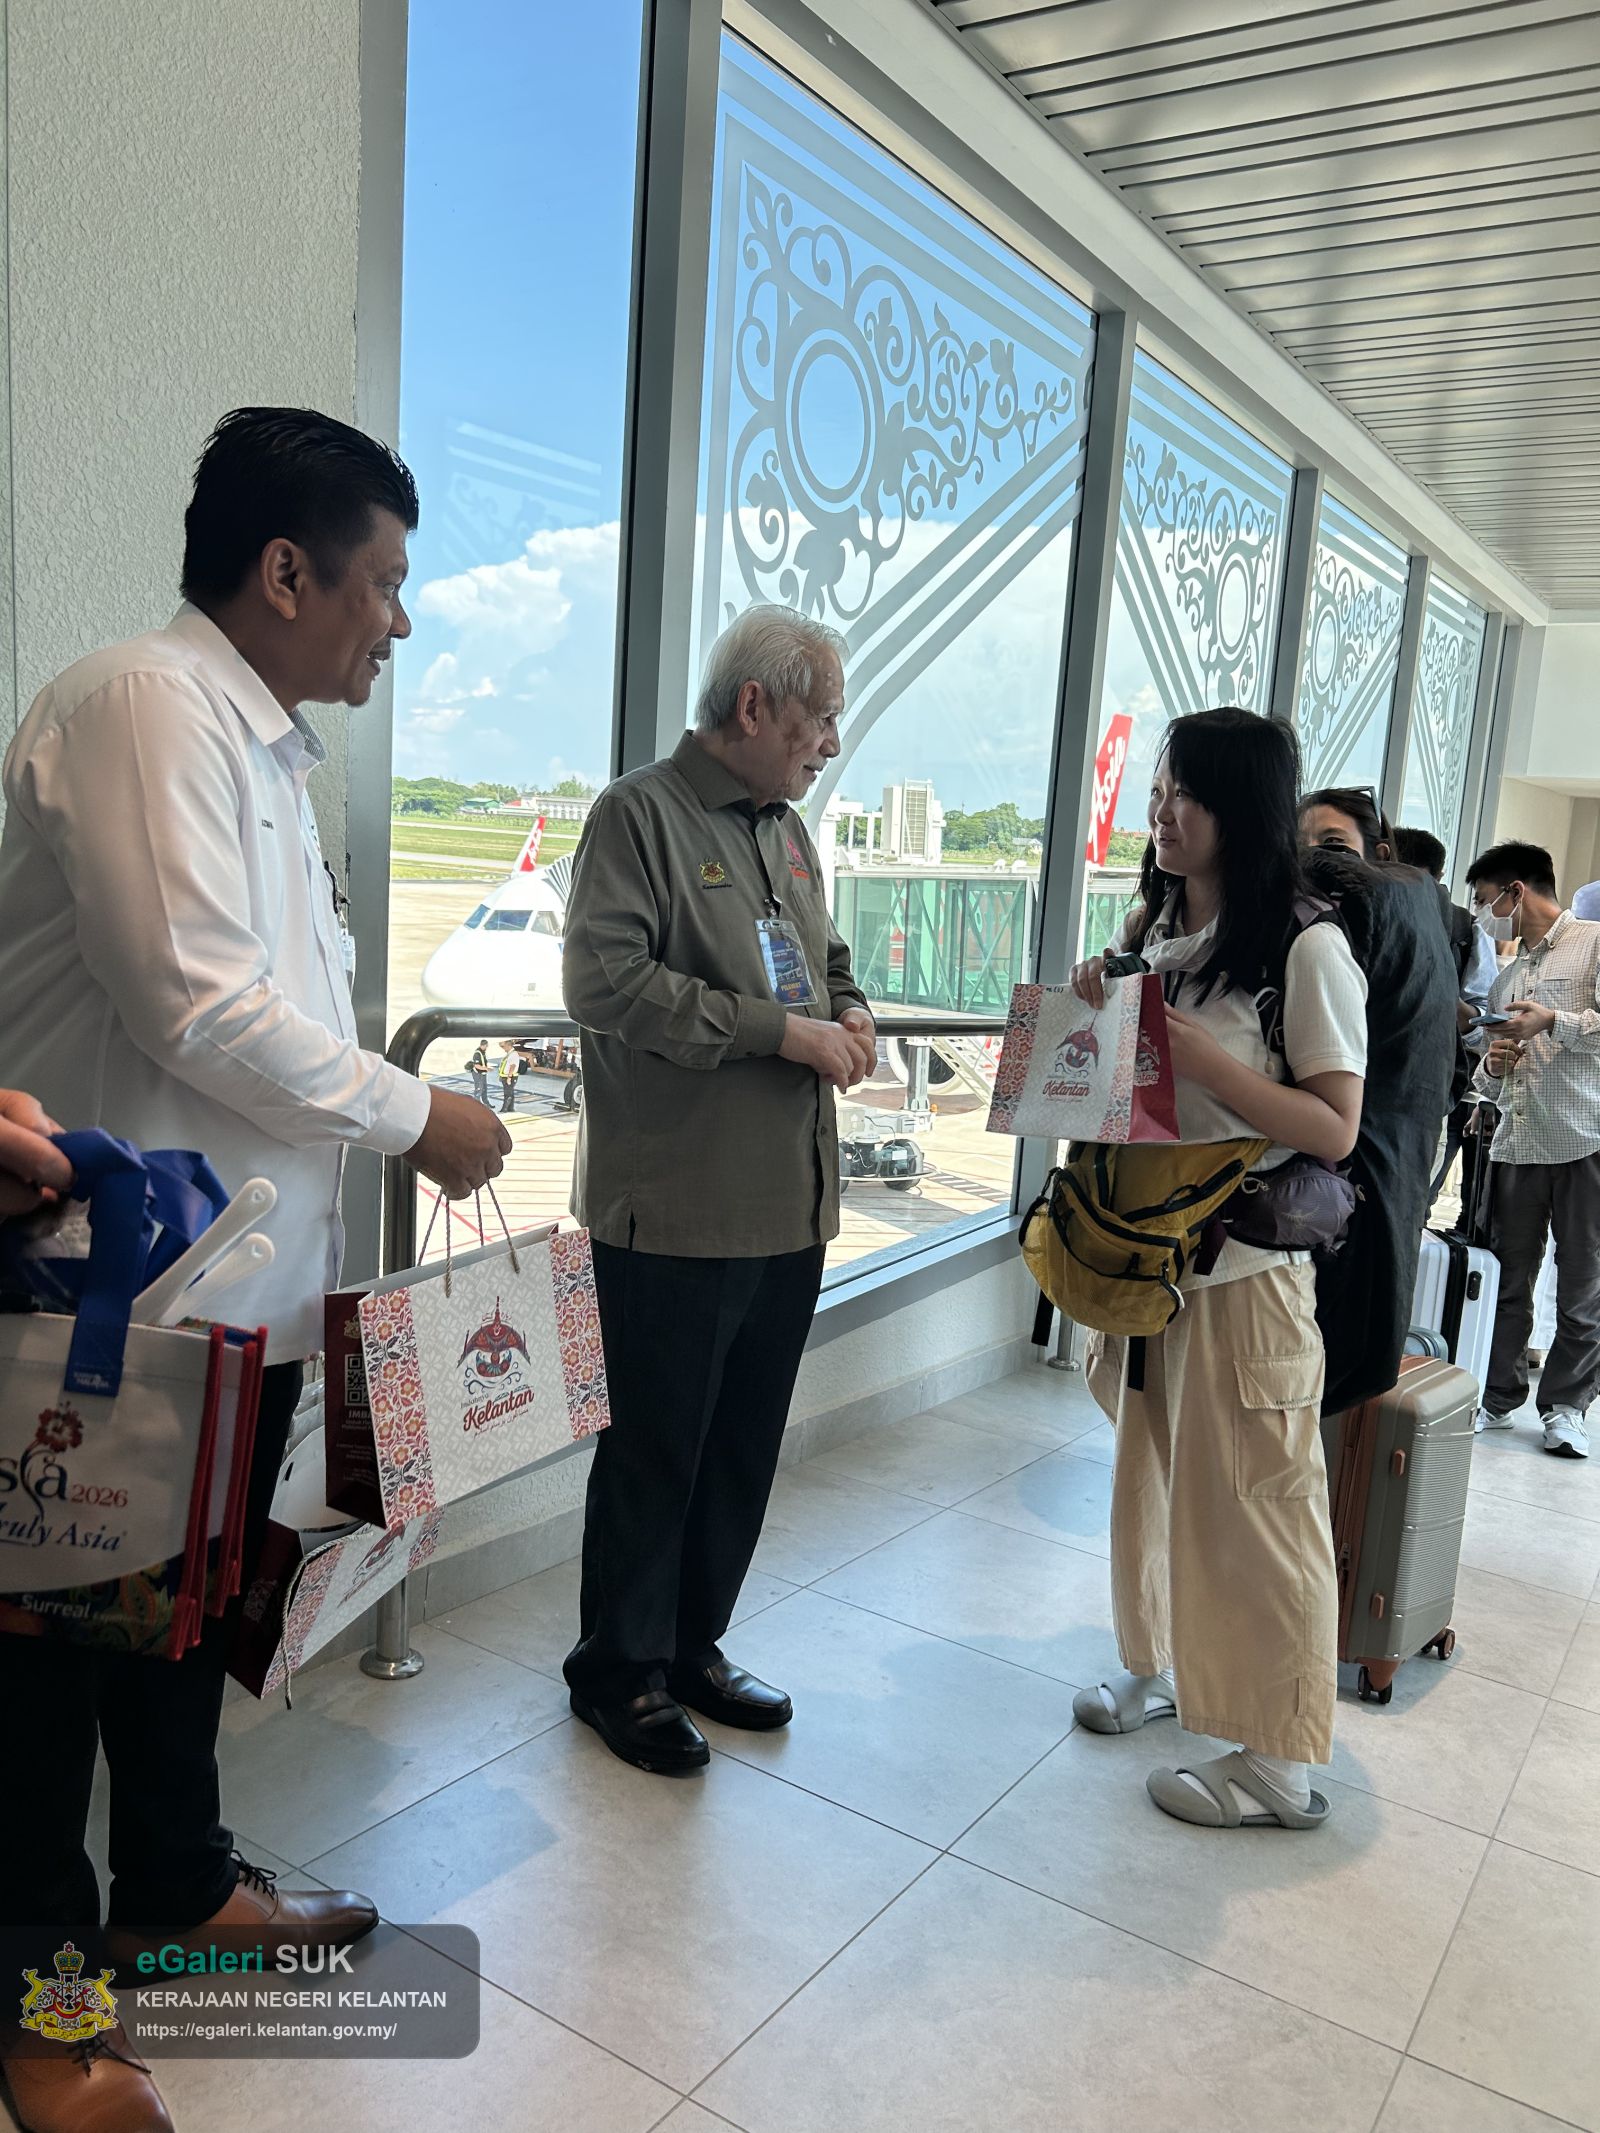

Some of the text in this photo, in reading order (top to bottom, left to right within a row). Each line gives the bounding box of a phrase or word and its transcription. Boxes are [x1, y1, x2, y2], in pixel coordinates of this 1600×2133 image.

[1042, 1080, 1090, 1097] Kelantan
[463, 1389, 535, 1432] Kelantan
[71, 1484, 129, 1508] 2026
[56, 1521, 121, 1551] Asia
[20, 1594, 91, 1619] Surreal
